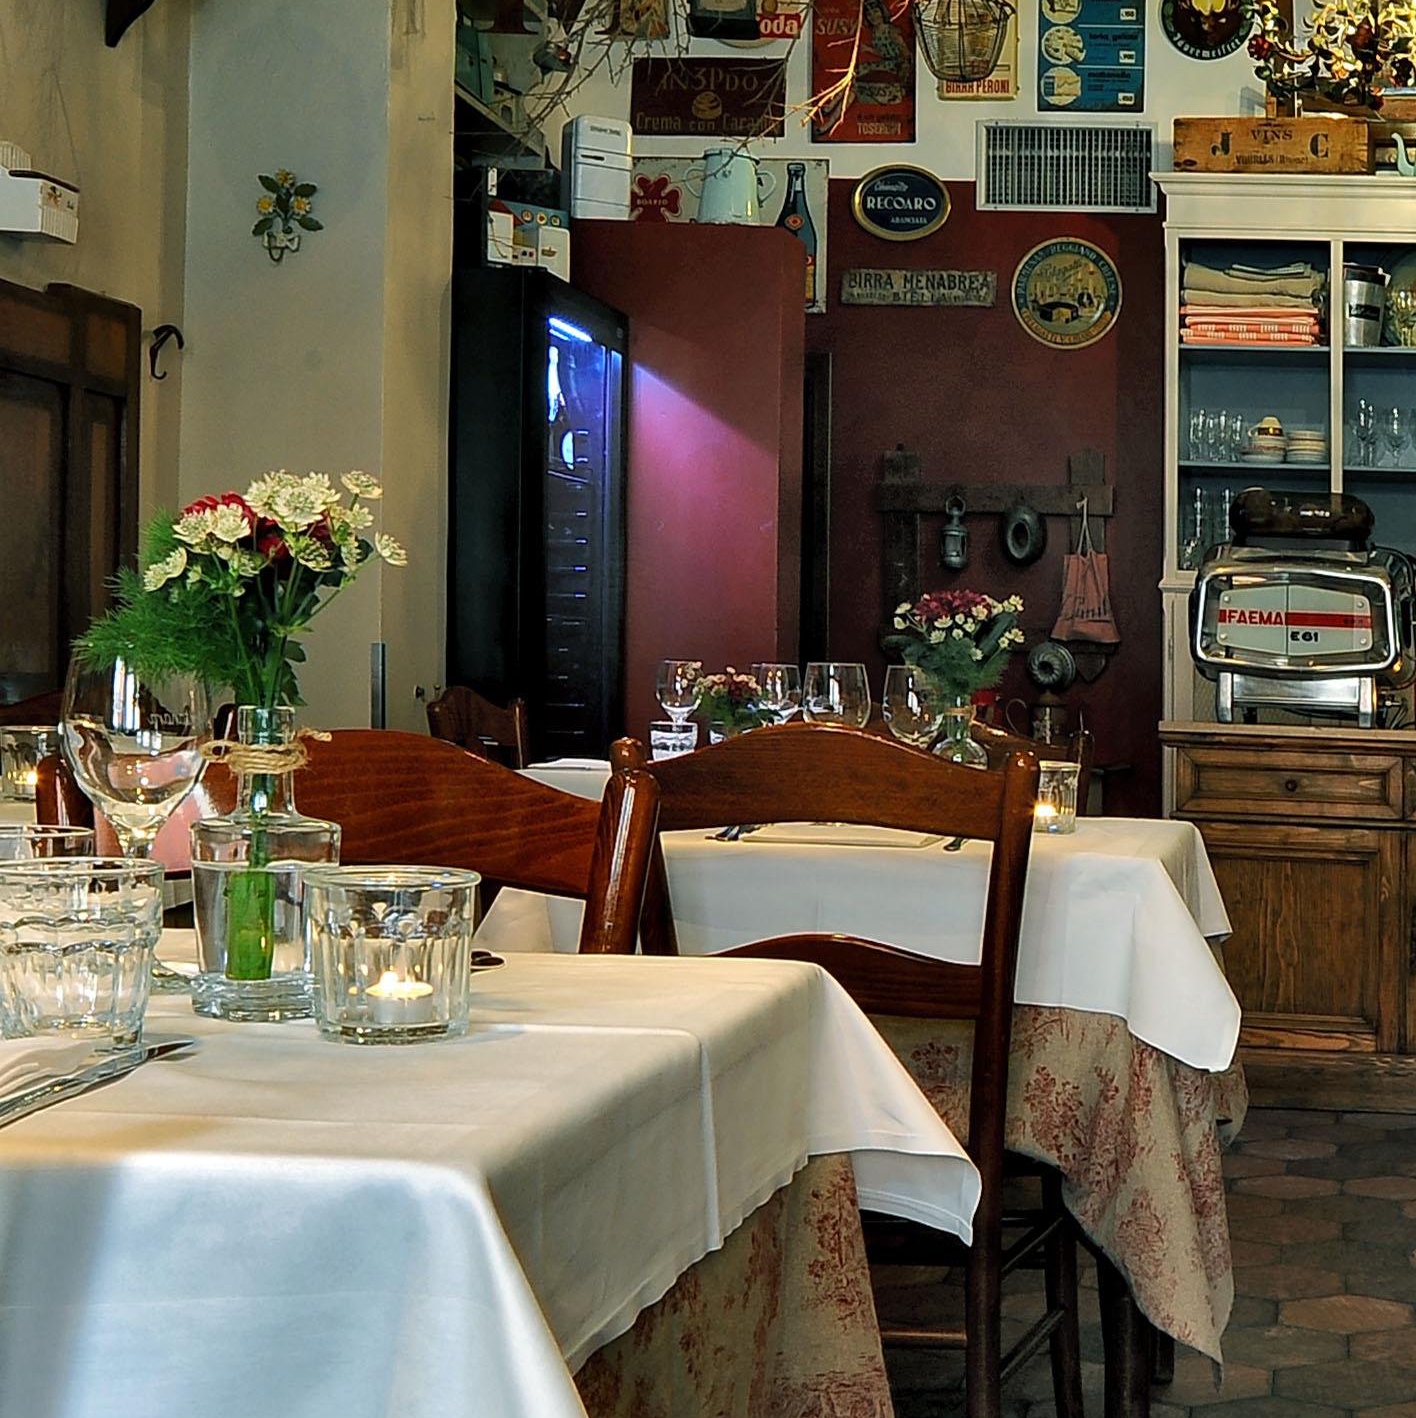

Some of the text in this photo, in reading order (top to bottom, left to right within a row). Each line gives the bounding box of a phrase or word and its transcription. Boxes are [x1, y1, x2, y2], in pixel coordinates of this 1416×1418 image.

[635, 111, 682, 131] Crema
[1211, 132, 1233, 156] J
[1250, 128, 1293, 141] VINS
[1309, 133, 1329, 158] C
[866, 196, 937, 211] RECOARO
[849, 273, 991, 292] BIRRA MENABREA
[1227, 609, 1284, 626] FAEMA
